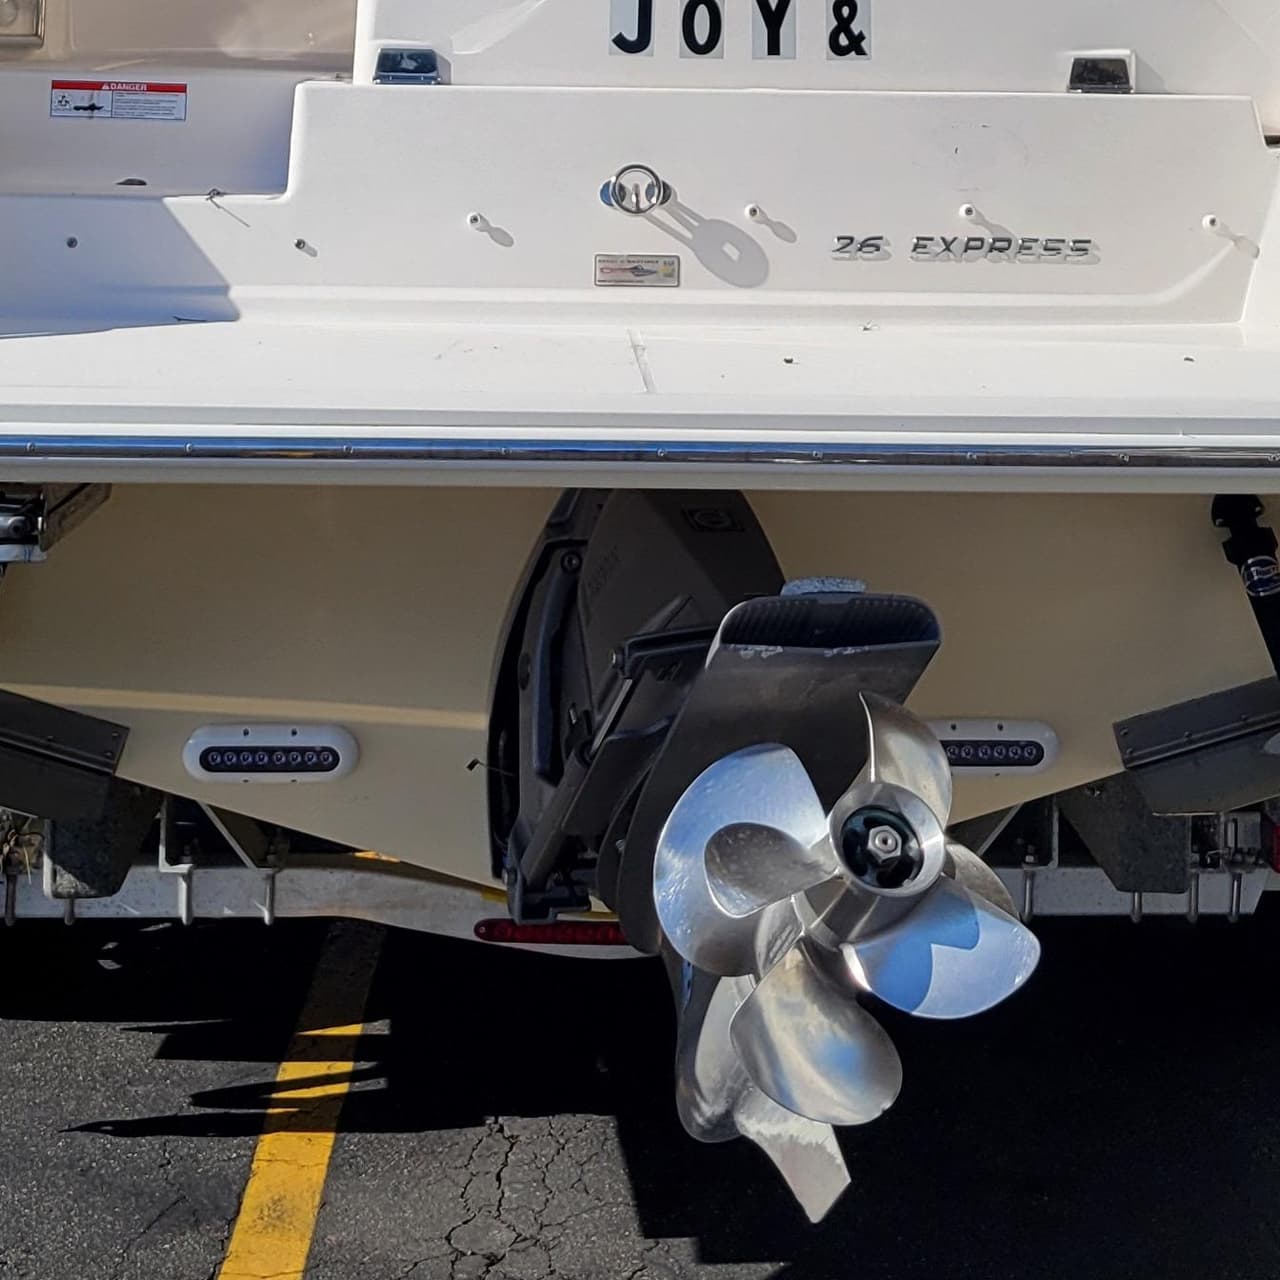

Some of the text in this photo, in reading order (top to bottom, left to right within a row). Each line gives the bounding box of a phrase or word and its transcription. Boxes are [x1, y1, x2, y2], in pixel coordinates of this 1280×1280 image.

[110, 82, 148, 91] DANGER
[832, 235, 1093, 258] 26 EXPRESS
